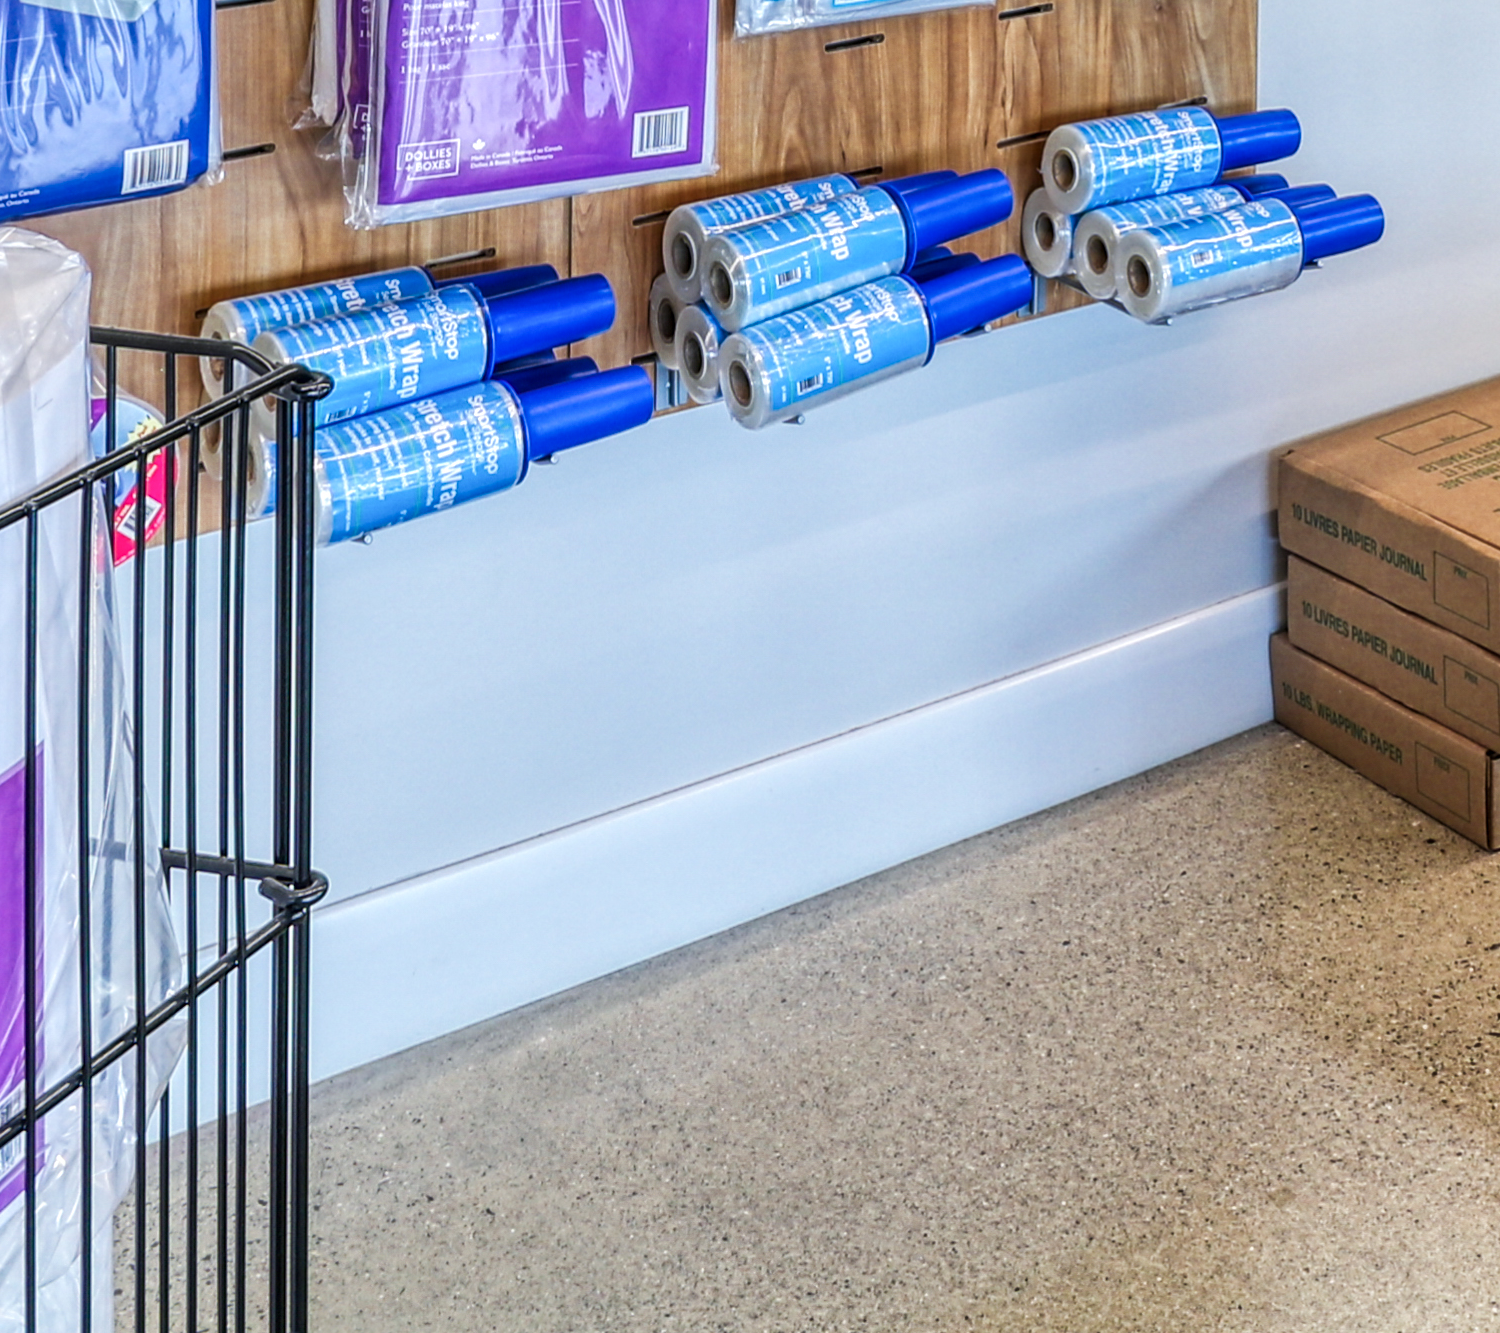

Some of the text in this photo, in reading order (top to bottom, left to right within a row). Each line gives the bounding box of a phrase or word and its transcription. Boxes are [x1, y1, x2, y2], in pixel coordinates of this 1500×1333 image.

[406, 148, 452, 162] DOLLIES
[416, 159, 451, 172] BOXES
[397, 341, 423, 398] Wrap
[435, 458, 462, 511] Wrap
[1292, 504, 1427, 581] 10 LIVRES PAPIER JOURNAL
[1302, 601, 1437, 684] 10 LIVRES PAPIER JOURNAL
[1282, 683, 1292, 700] 10
[1317, 704, 1367, 743] WRAPPING
[1371, 733, 1402, 765] PAPER
